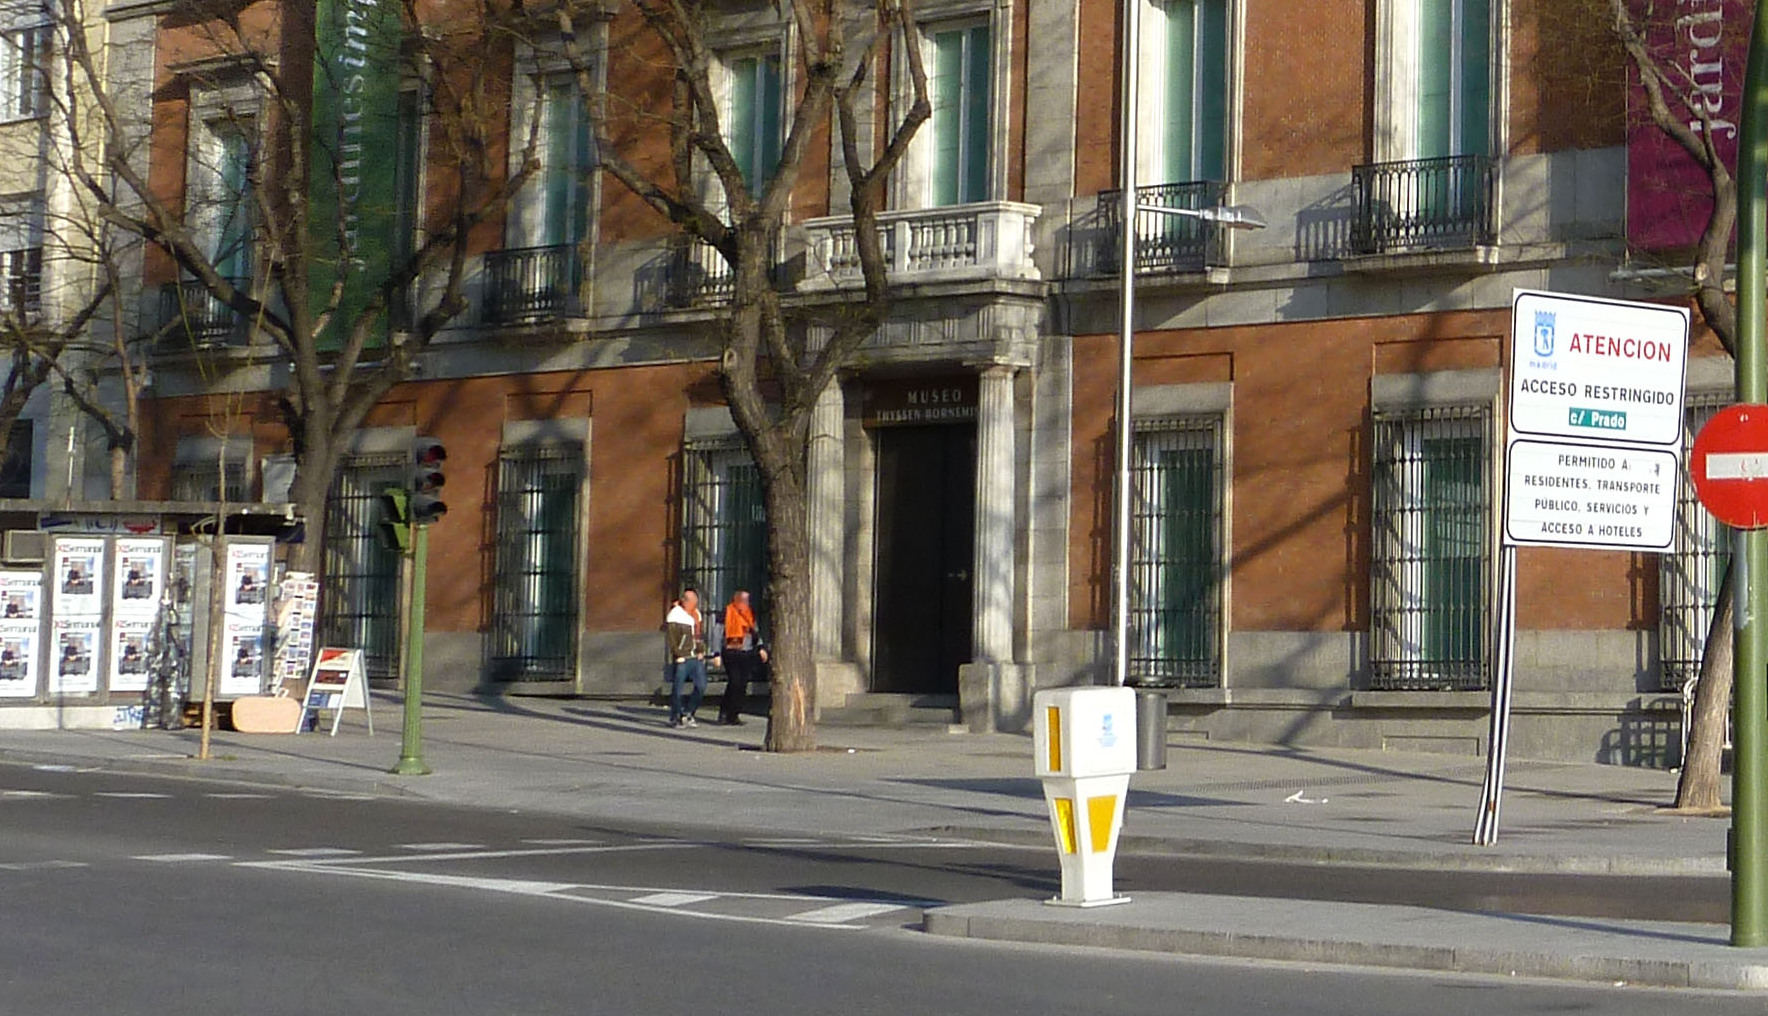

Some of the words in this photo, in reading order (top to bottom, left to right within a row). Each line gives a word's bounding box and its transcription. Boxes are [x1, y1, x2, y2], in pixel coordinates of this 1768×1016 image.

[1569, 332, 1671, 363] ATENCION
[907, 389, 962, 404] MUSEO
[1520, 378, 1577, 397] ACCESO
[1584, 384, 1674, 406] RESTRINGIDO
[1570, 409, 1585, 425] c/
[1591, 411, 1625, 428] Prado
[1558, 454, 1616, 470] PERMITIDO
[1597, 479, 1661, 495] TRANSPORTE
[1586, 502, 1638, 515] SERVICIOS
[1643, 505, 1649, 516] Y
[1541, 521, 1583, 535] ACCESO
[1587, 524, 1594, 535] A
[1598, 525, 1643, 537] HOTELES
